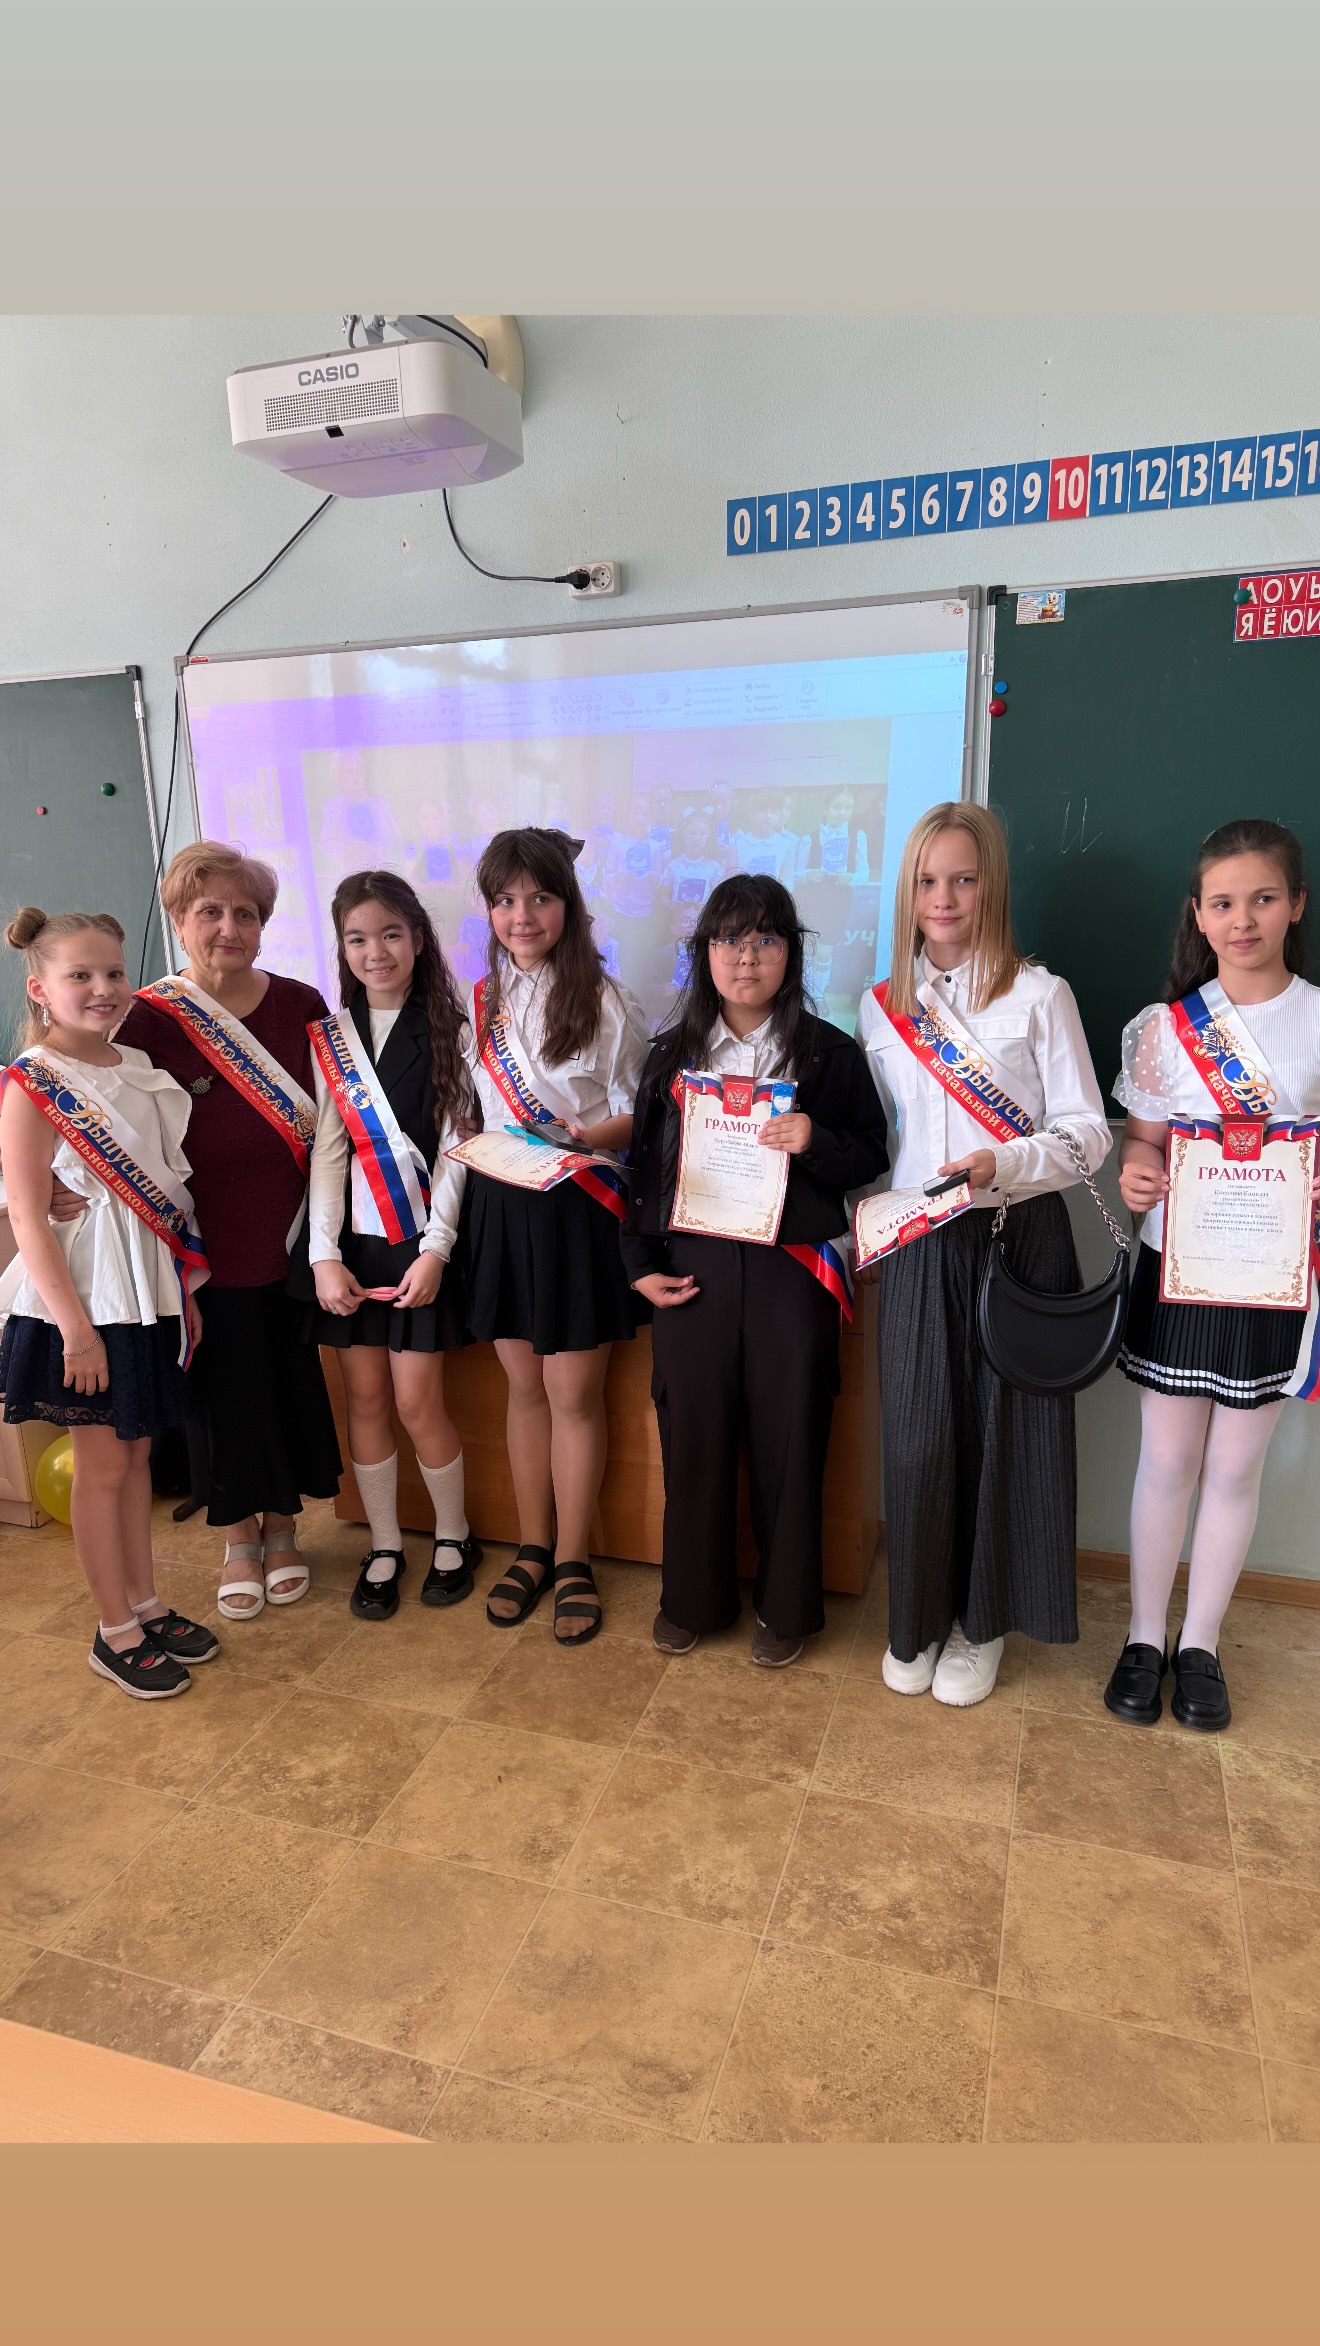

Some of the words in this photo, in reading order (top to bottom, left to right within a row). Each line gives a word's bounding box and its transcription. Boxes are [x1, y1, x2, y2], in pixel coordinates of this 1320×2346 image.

[297, 362, 360, 386] CASIO
[733, 508, 751, 546] 0
[765, 504, 777, 543] 1
[794, 500, 811, 540] 2
[825, 496, 842, 537] 3
[856, 492, 875, 532] 4
[888, 488, 906, 529] 5
[921, 484, 940, 525] 6
[956, 480, 974, 522] 7
[988, 476, 1008, 518] 8
[1022, 472, 1042, 514] 9
[1054, 466, 1085, 510] 10
[1095, 462, 1124, 505] 11
[1135, 457, 1167, 501] 12
[1176, 453, 1208, 498] 13
[1218, 448, 1253, 493] 14
[1261, 443, 1296, 489] 15
[1304, 440, 1320, 484] 1
[169, 1000, 292, 1121] РУКОВОДИТЕЛЬ
[208, 1010, 285, 1086] Классный
[317, 1035, 340, 1081] школы
[321, 1014, 359, 1074] ускник
[929, 1057, 1002, 1128] начальной
[55, 1087, 171, 1211] Выпускник
[704, 1117, 761, 1135] ГРАМОТ
[43, 1103, 118, 1181] начальной
[112, 1178, 157, 1224] школы
[1198, 1166, 1287, 1182] ГРАМОТА
[876, 1193, 943, 1235] ГРАМОТА
